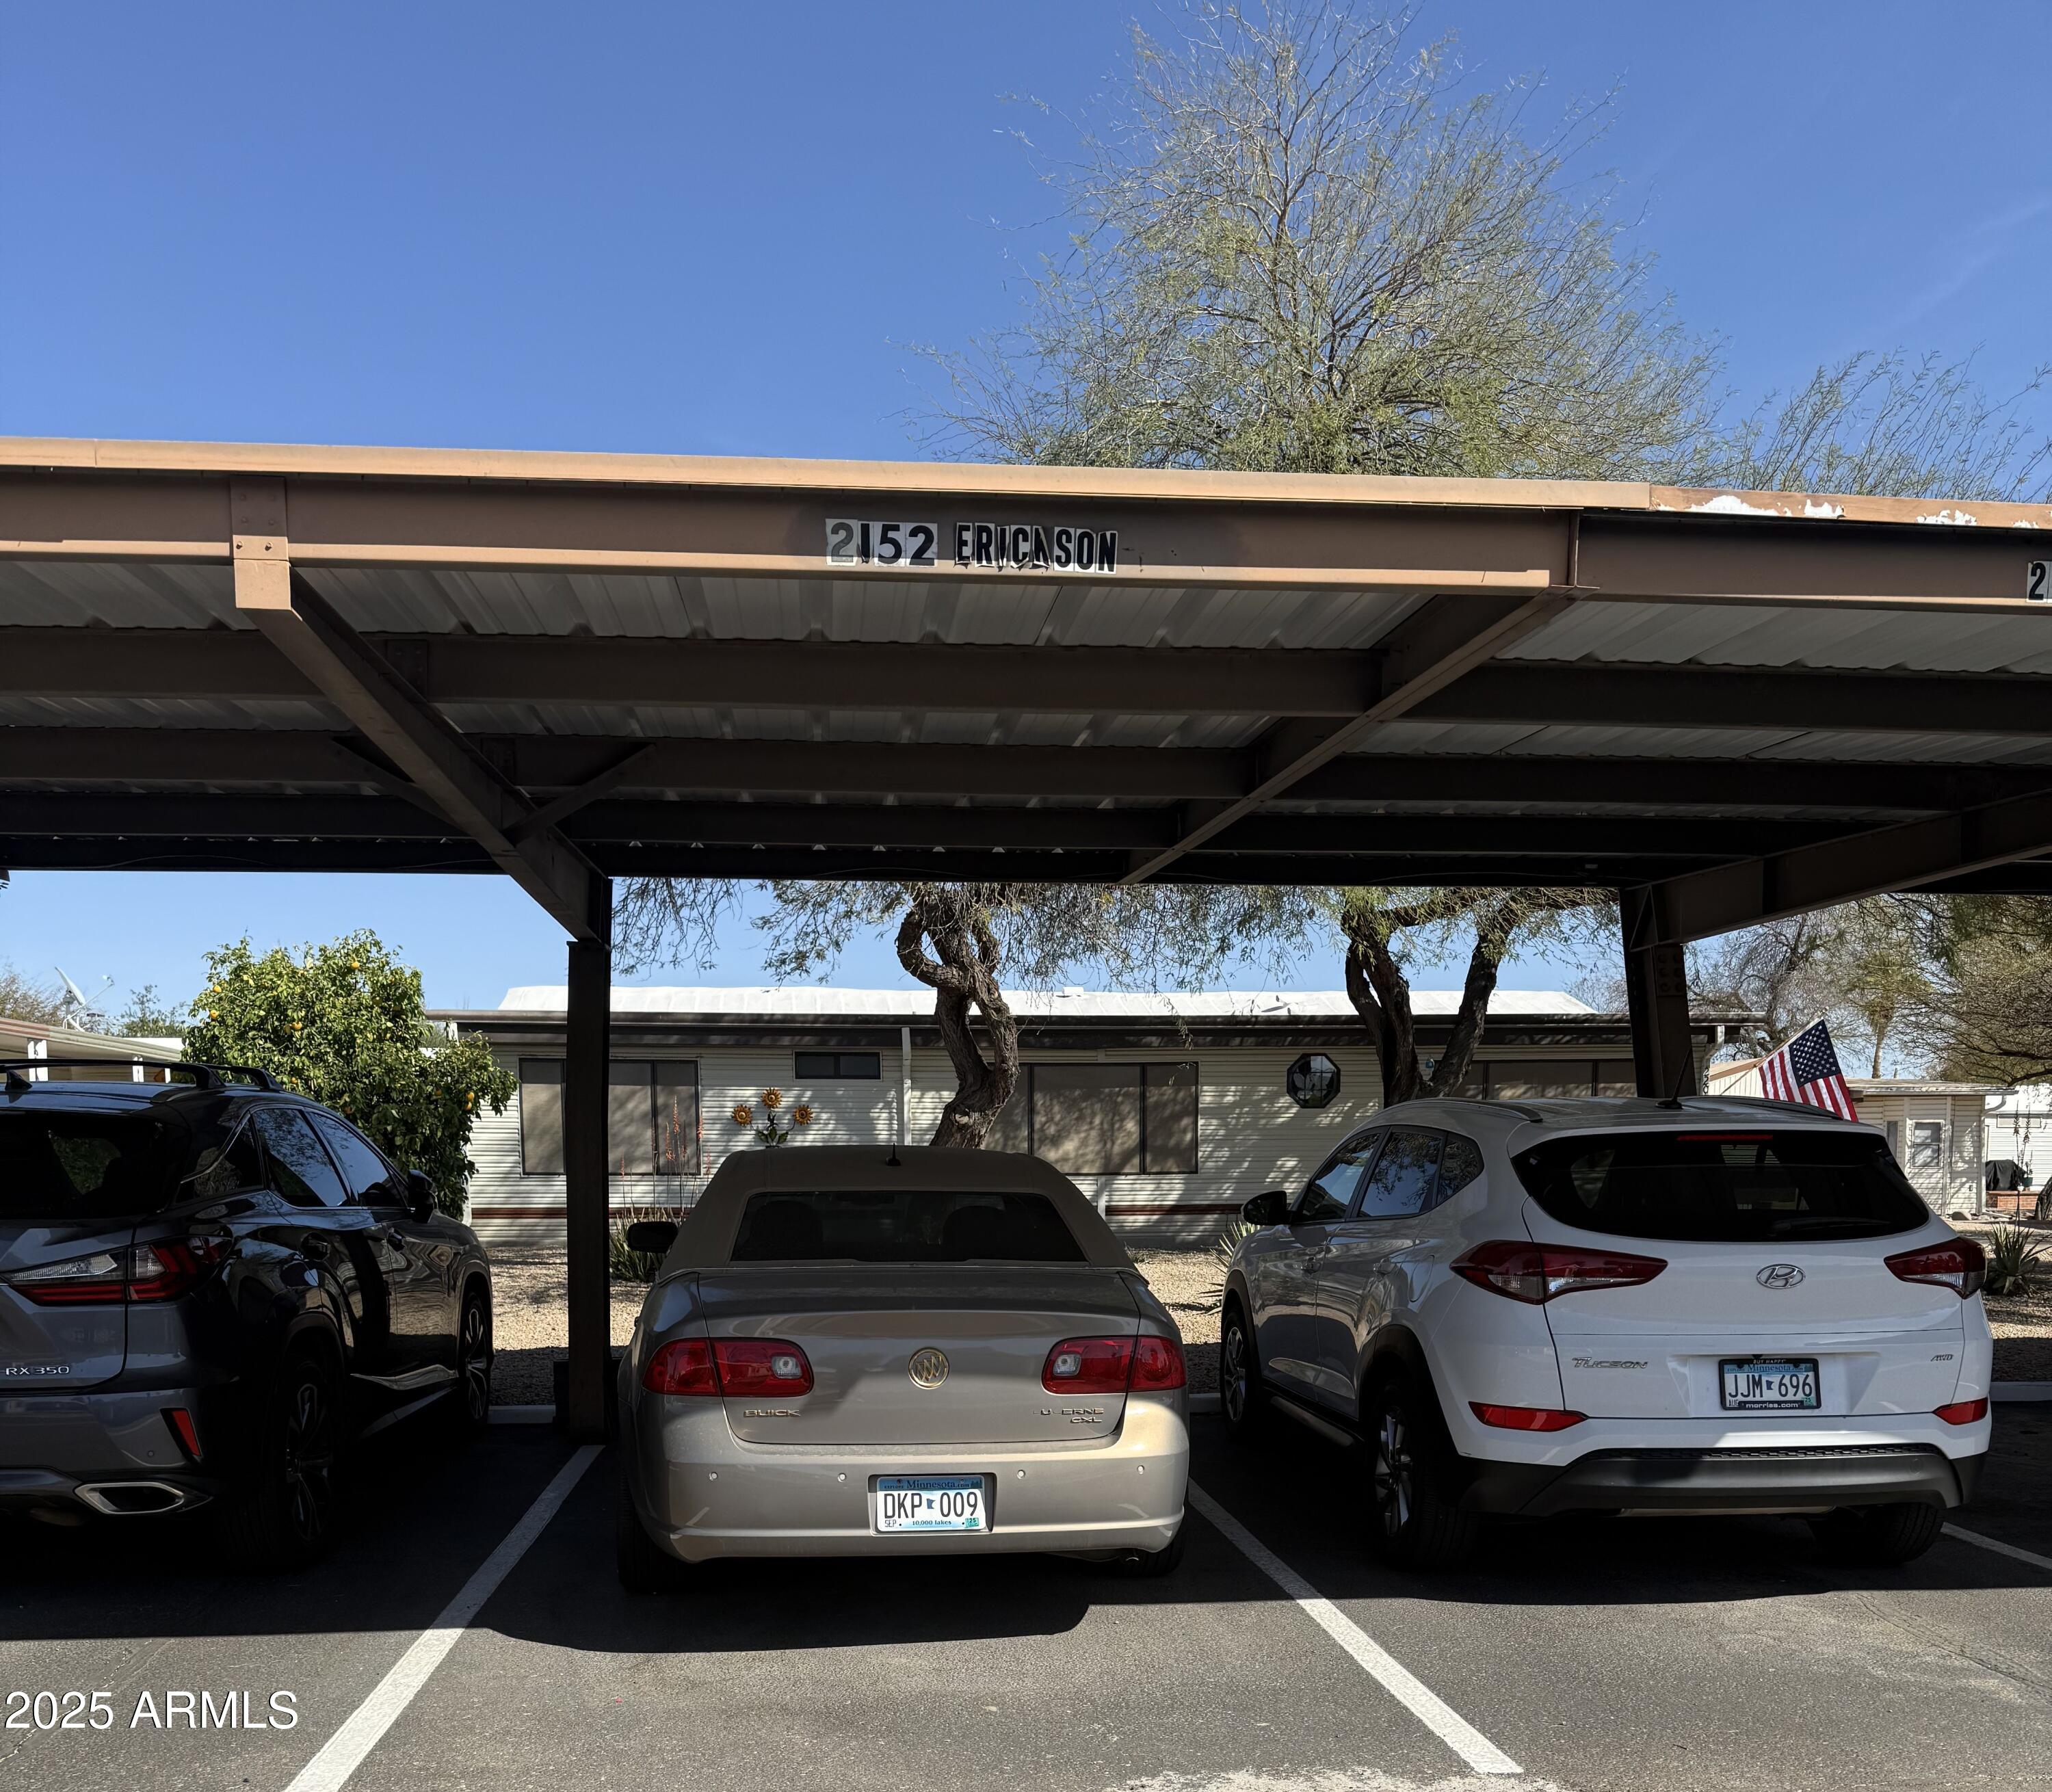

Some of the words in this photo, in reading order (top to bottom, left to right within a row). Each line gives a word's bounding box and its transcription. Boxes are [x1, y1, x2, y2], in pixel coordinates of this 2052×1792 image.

[830, 522, 935, 566] 2152
[5, 1367, 30, 1375] RX
[34, 1366, 70, 1374] 350
[1728, 1373, 1763, 1398] JJM
[1778, 1373, 1813, 1397] 696
[743, 1409, 801, 1418] BUICK
[884, 1492, 923, 1519] DKP
[940, 1491, 978, 1518] 009
[884, 1519, 897, 1527] SEP
